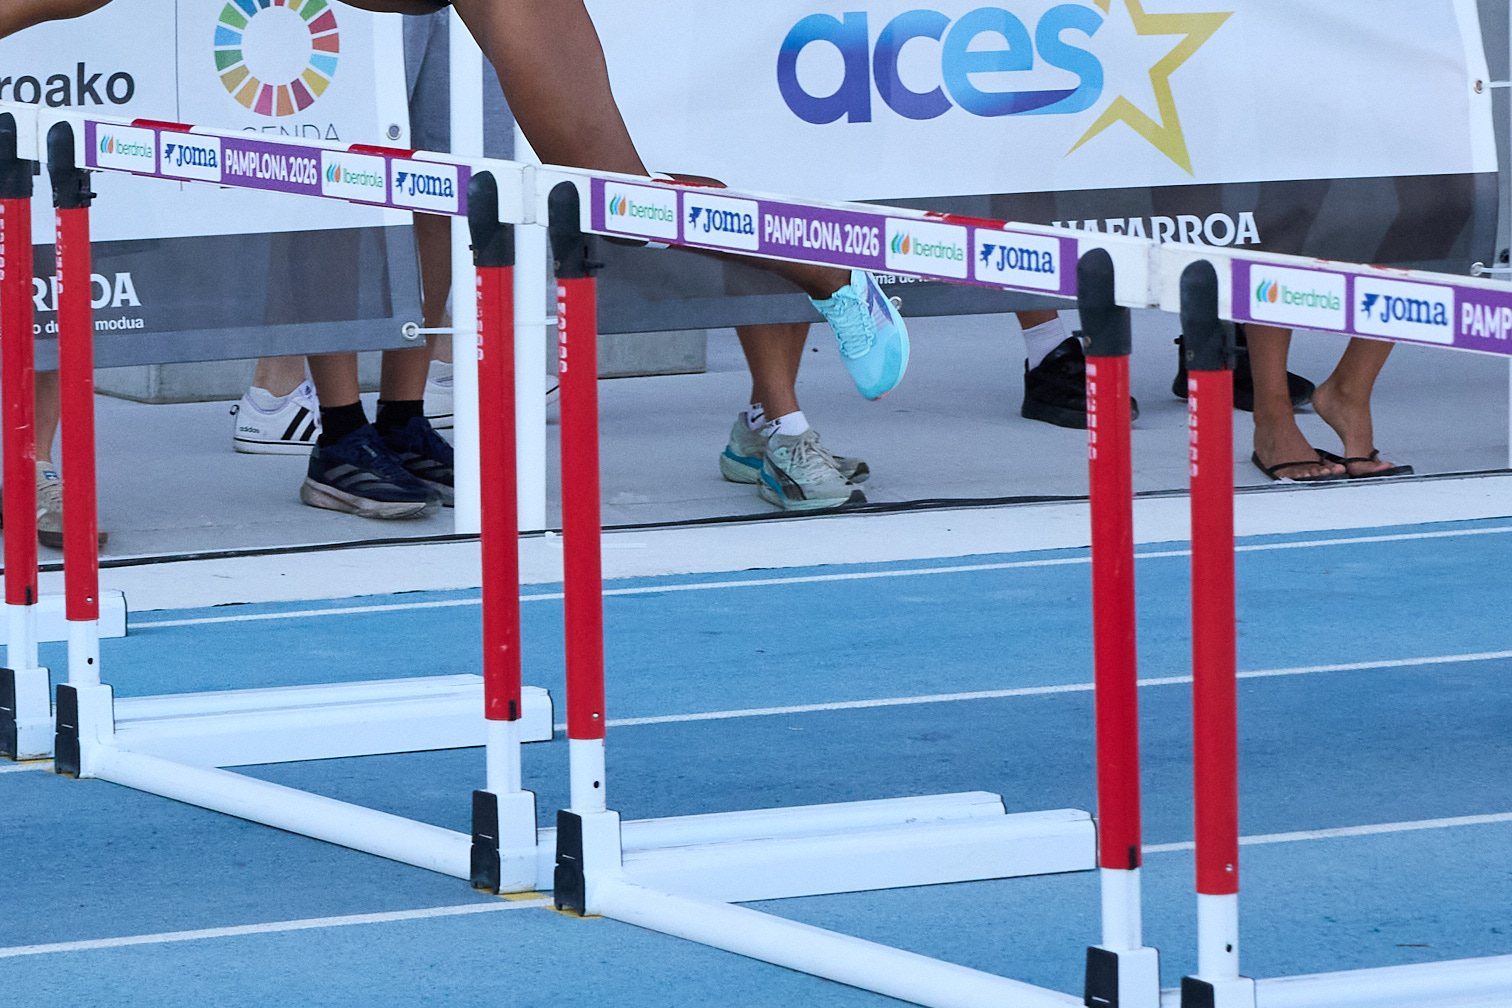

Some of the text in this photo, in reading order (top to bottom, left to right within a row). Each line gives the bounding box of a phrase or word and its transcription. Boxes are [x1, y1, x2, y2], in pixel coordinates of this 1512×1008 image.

[777, 3, 1104, 124] aces
[116, 140, 153, 159] Iberdrola
[176, 144, 218, 168] Joma
[225, 149, 318, 185] PAMPLONA 2026
[343, 167, 384, 189] Iberdrola
[407, 173, 454, 198] Joma
[628, 200, 674, 224] Iberdrola
[703, 207, 755, 236] Joma
[764, 213, 880, 257] PAMPLONA 2026
[912, 237, 964, 262] Iberdrola
[996, 245, 1055, 274] Joma
[1281, 284, 1341, 312] Iberdrola
[1379, 293, 1448, 327] Joma
[94, 317, 144, 331] modua
